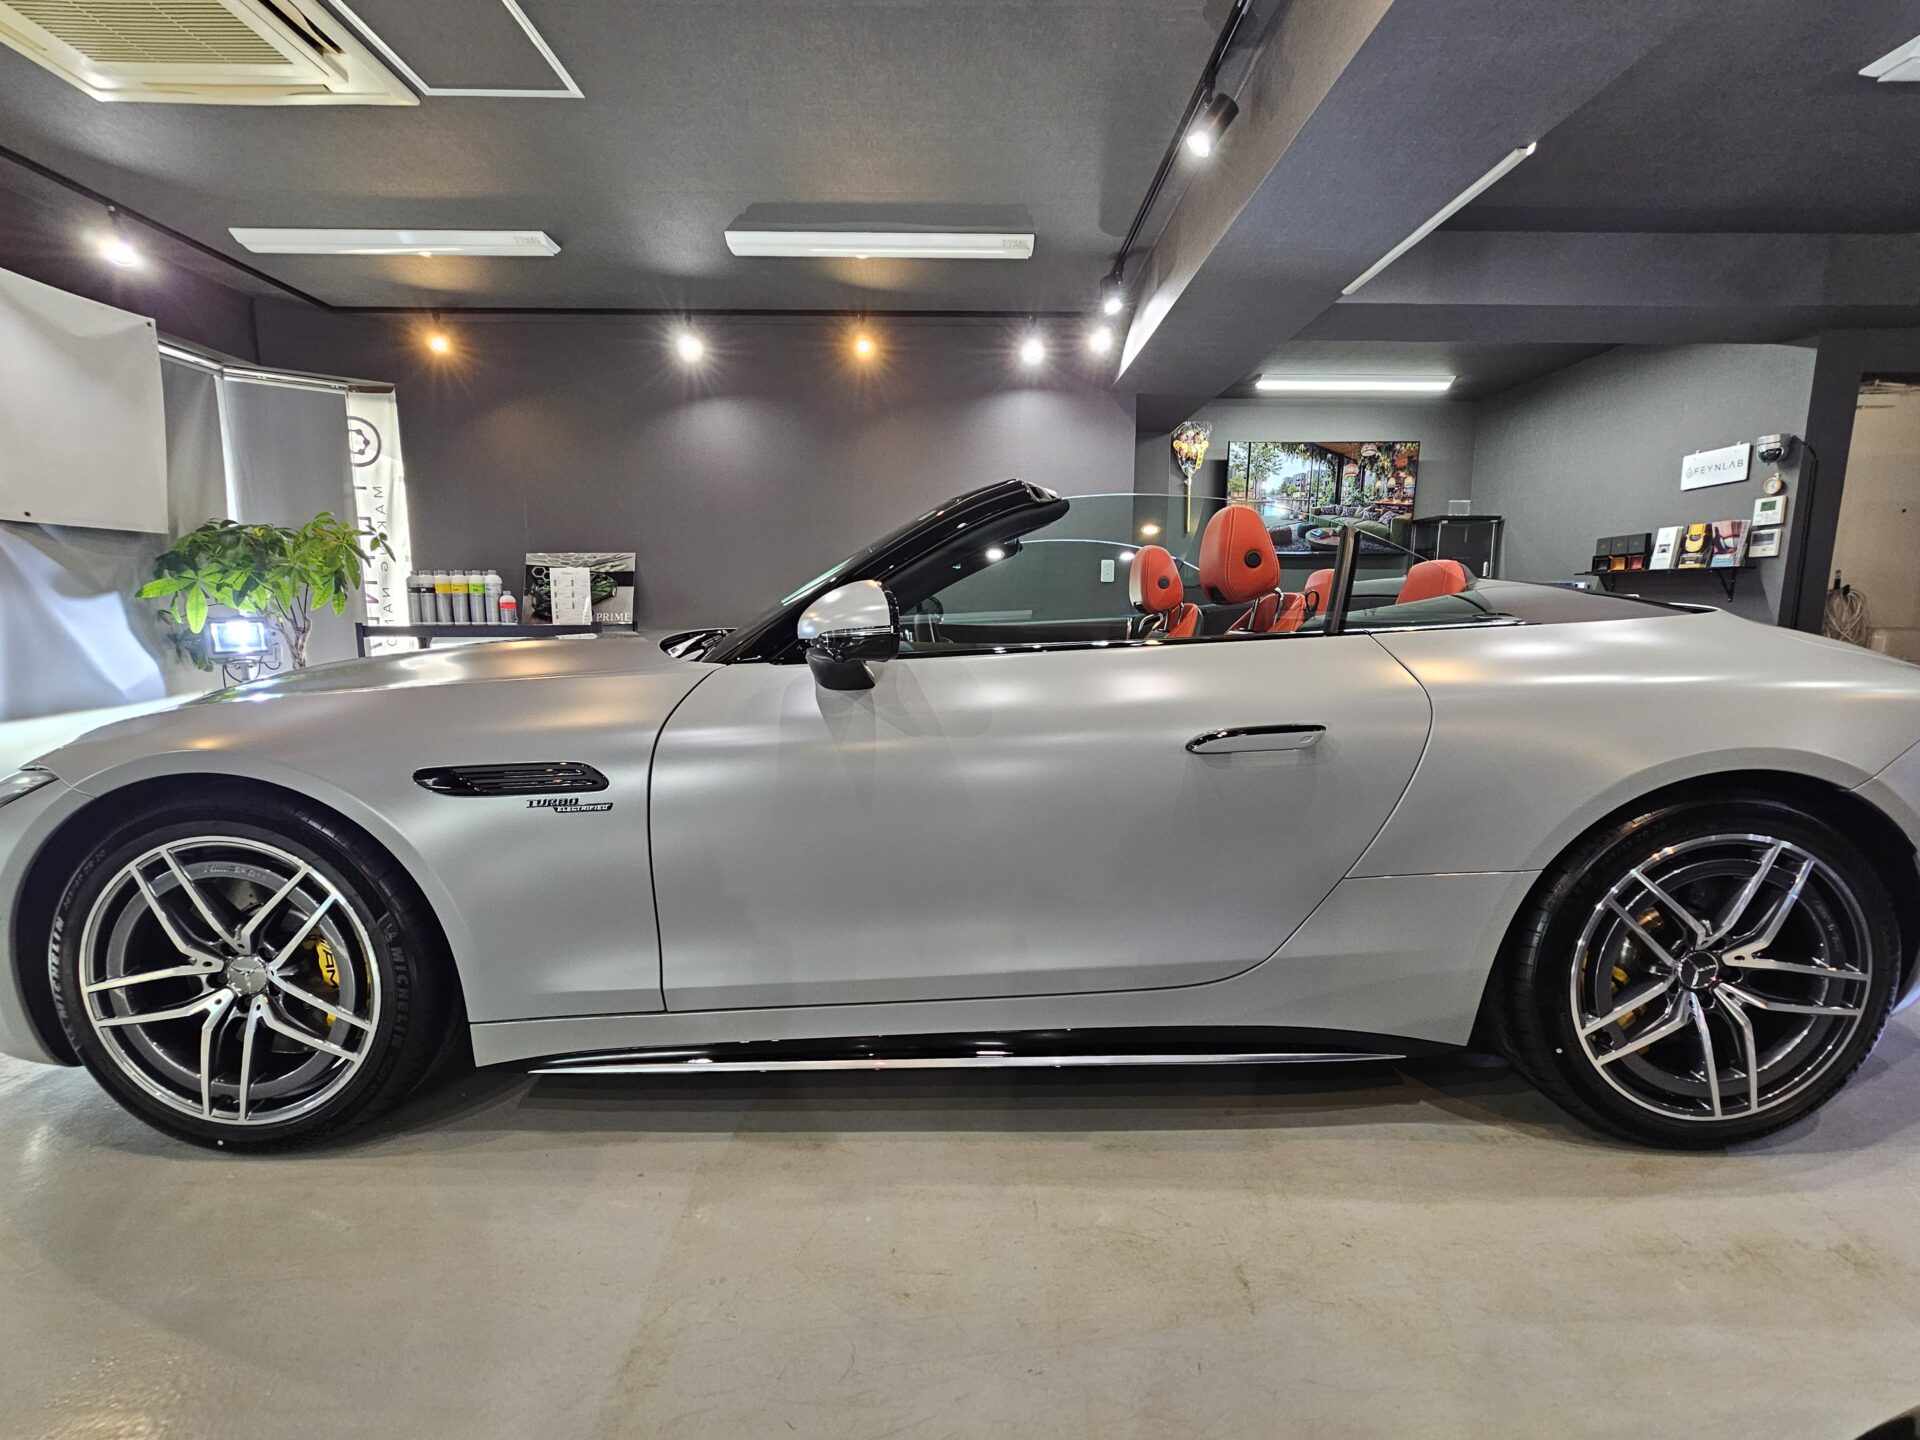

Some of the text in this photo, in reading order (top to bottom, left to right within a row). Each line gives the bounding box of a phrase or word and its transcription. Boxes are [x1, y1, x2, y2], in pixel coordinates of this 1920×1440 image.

[1693, 459, 1744, 475] FEYNLAB
[597, 612, 631, 623] PRIME
[526, 798, 579, 809] TURBO
[556, 804, 609, 812] ELECTRIFIED
[51, 916, 68, 1019] MICHELIN
[390, 947, 410, 1048] MICHELIN
